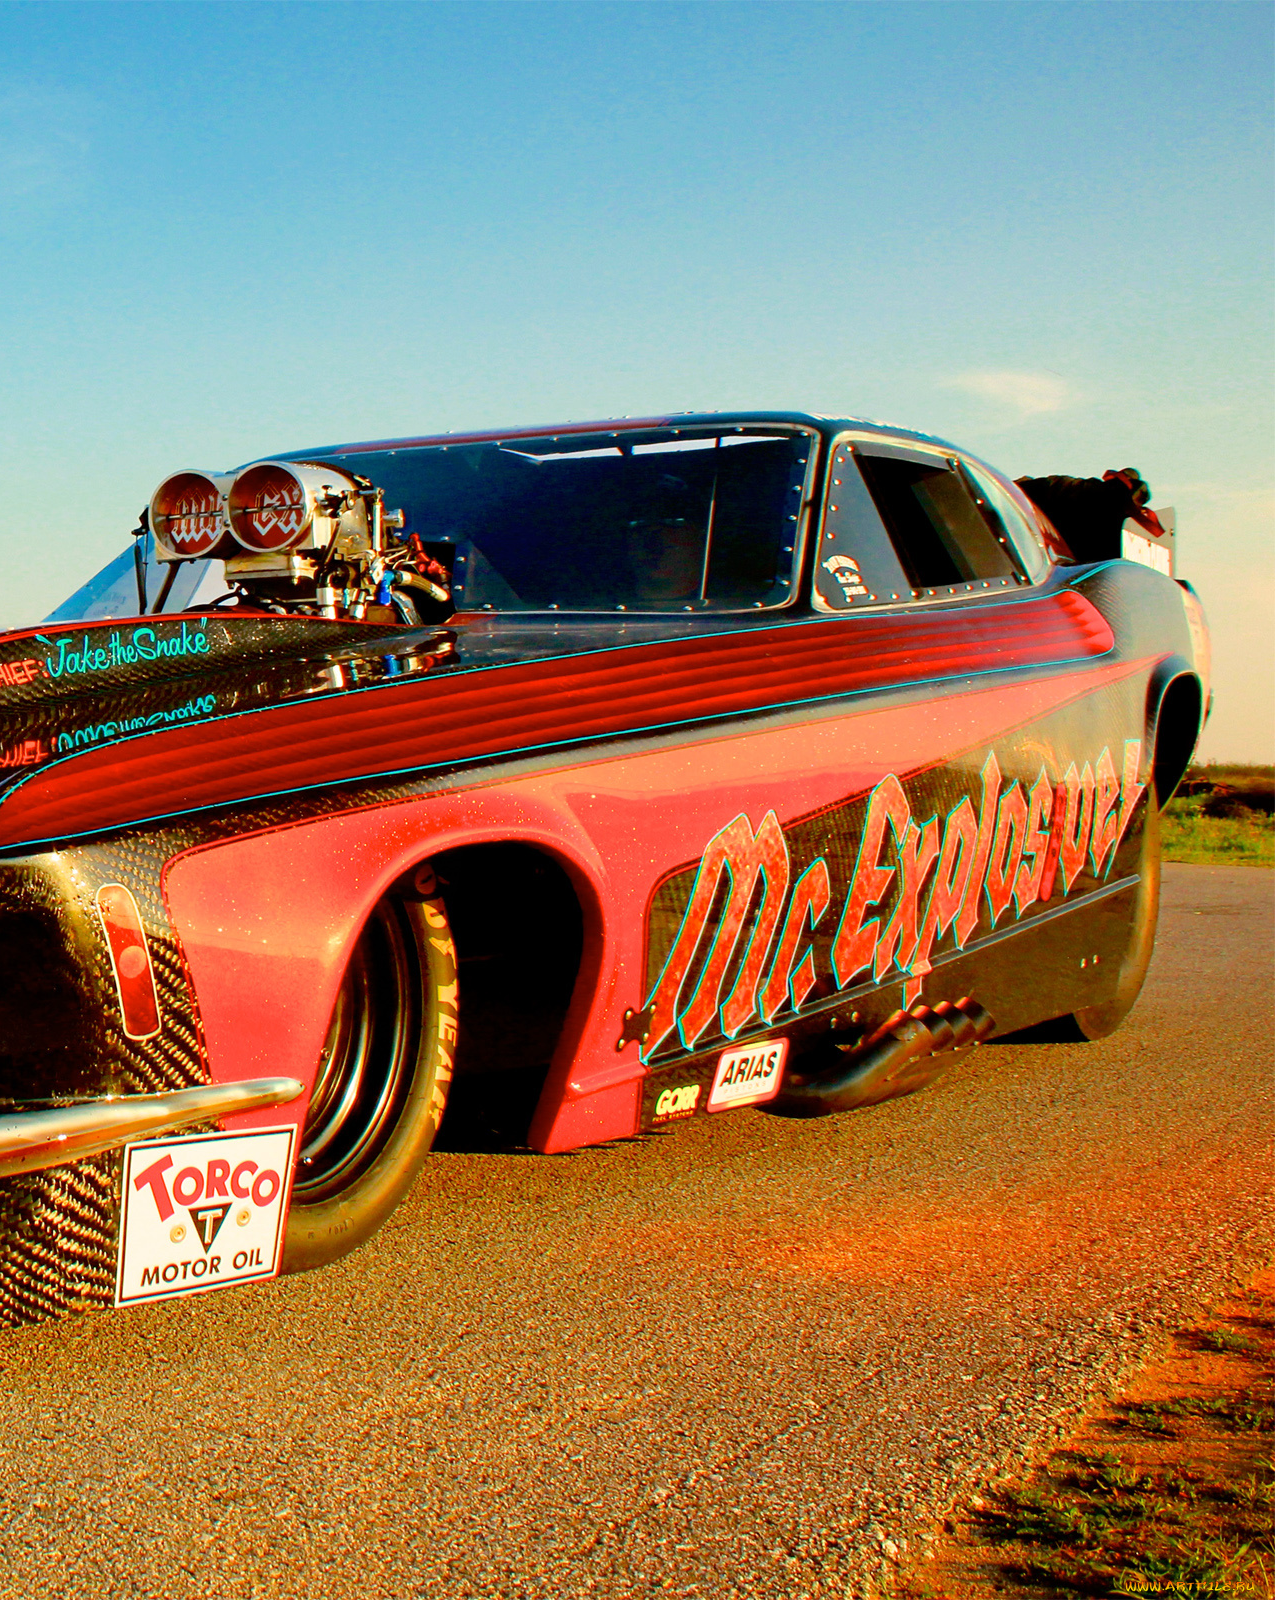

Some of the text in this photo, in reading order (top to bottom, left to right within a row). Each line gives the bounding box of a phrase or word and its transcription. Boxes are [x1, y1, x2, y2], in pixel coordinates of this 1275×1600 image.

[718, 1050, 778, 1088] ARIAS
[655, 1084, 702, 1116] GORR
[133, 1153, 281, 1223] TORCO
[140, 1248, 264, 1288] MOTOR OIL
